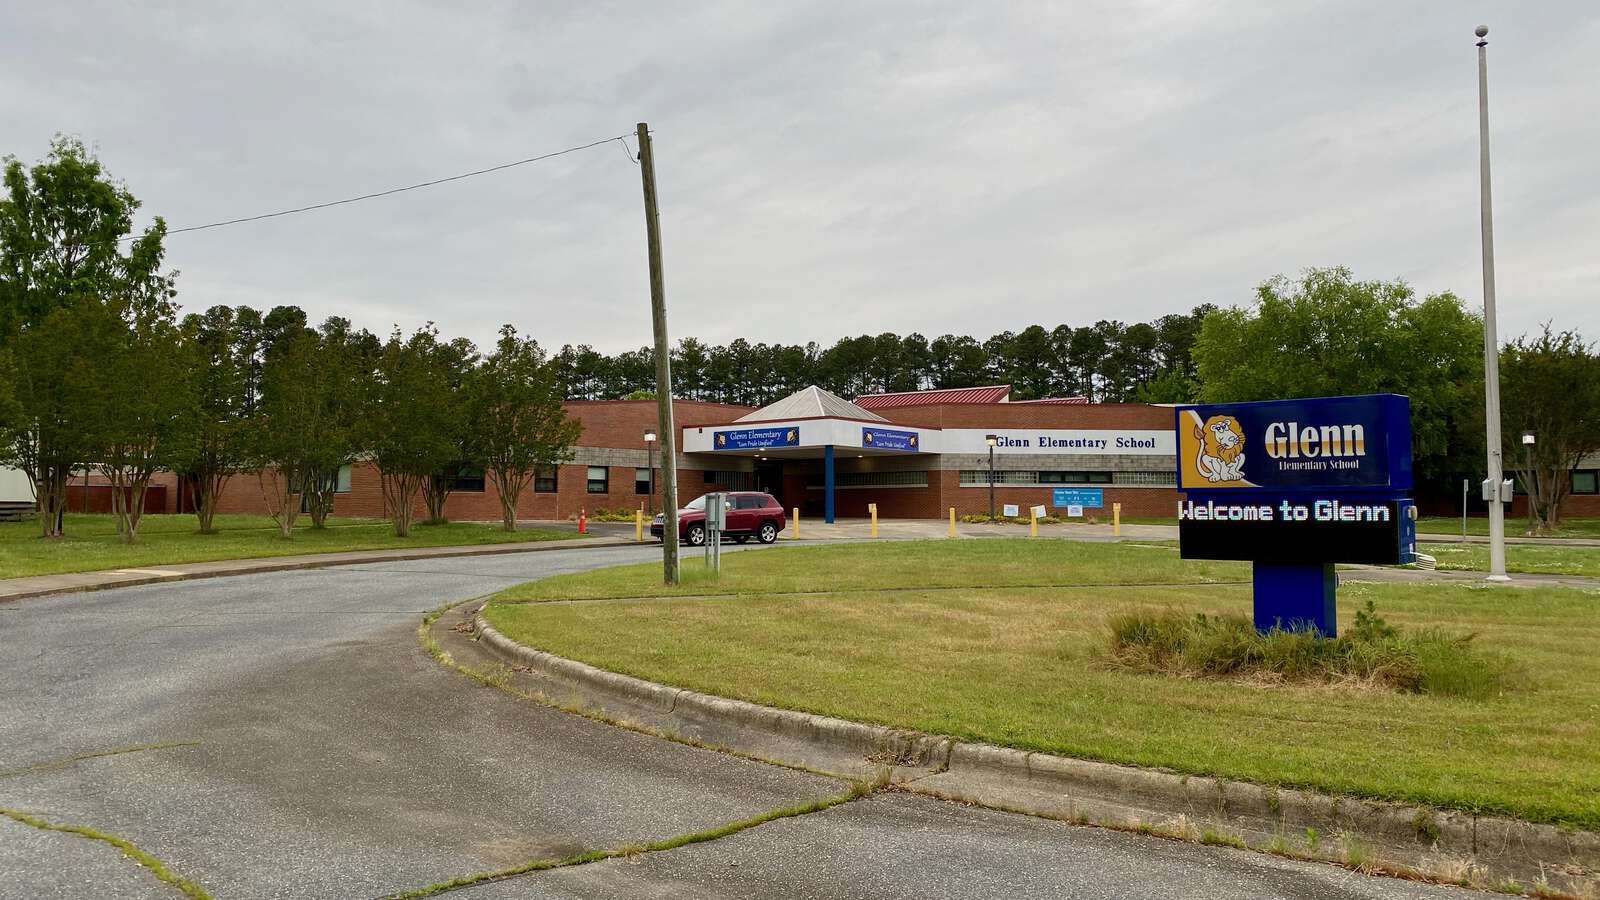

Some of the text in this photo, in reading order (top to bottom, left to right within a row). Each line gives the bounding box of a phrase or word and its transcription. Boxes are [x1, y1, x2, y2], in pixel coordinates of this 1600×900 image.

[730, 429, 782, 441] Glenn Elementary
[1264, 421, 1366, 459] Glenn
[995, 436, 1156, 450] Glenn Elementary School
[1279, 458, 1360, 471] Elementary School
[1177, 499, 1391, 521] Welcome to Glenn
